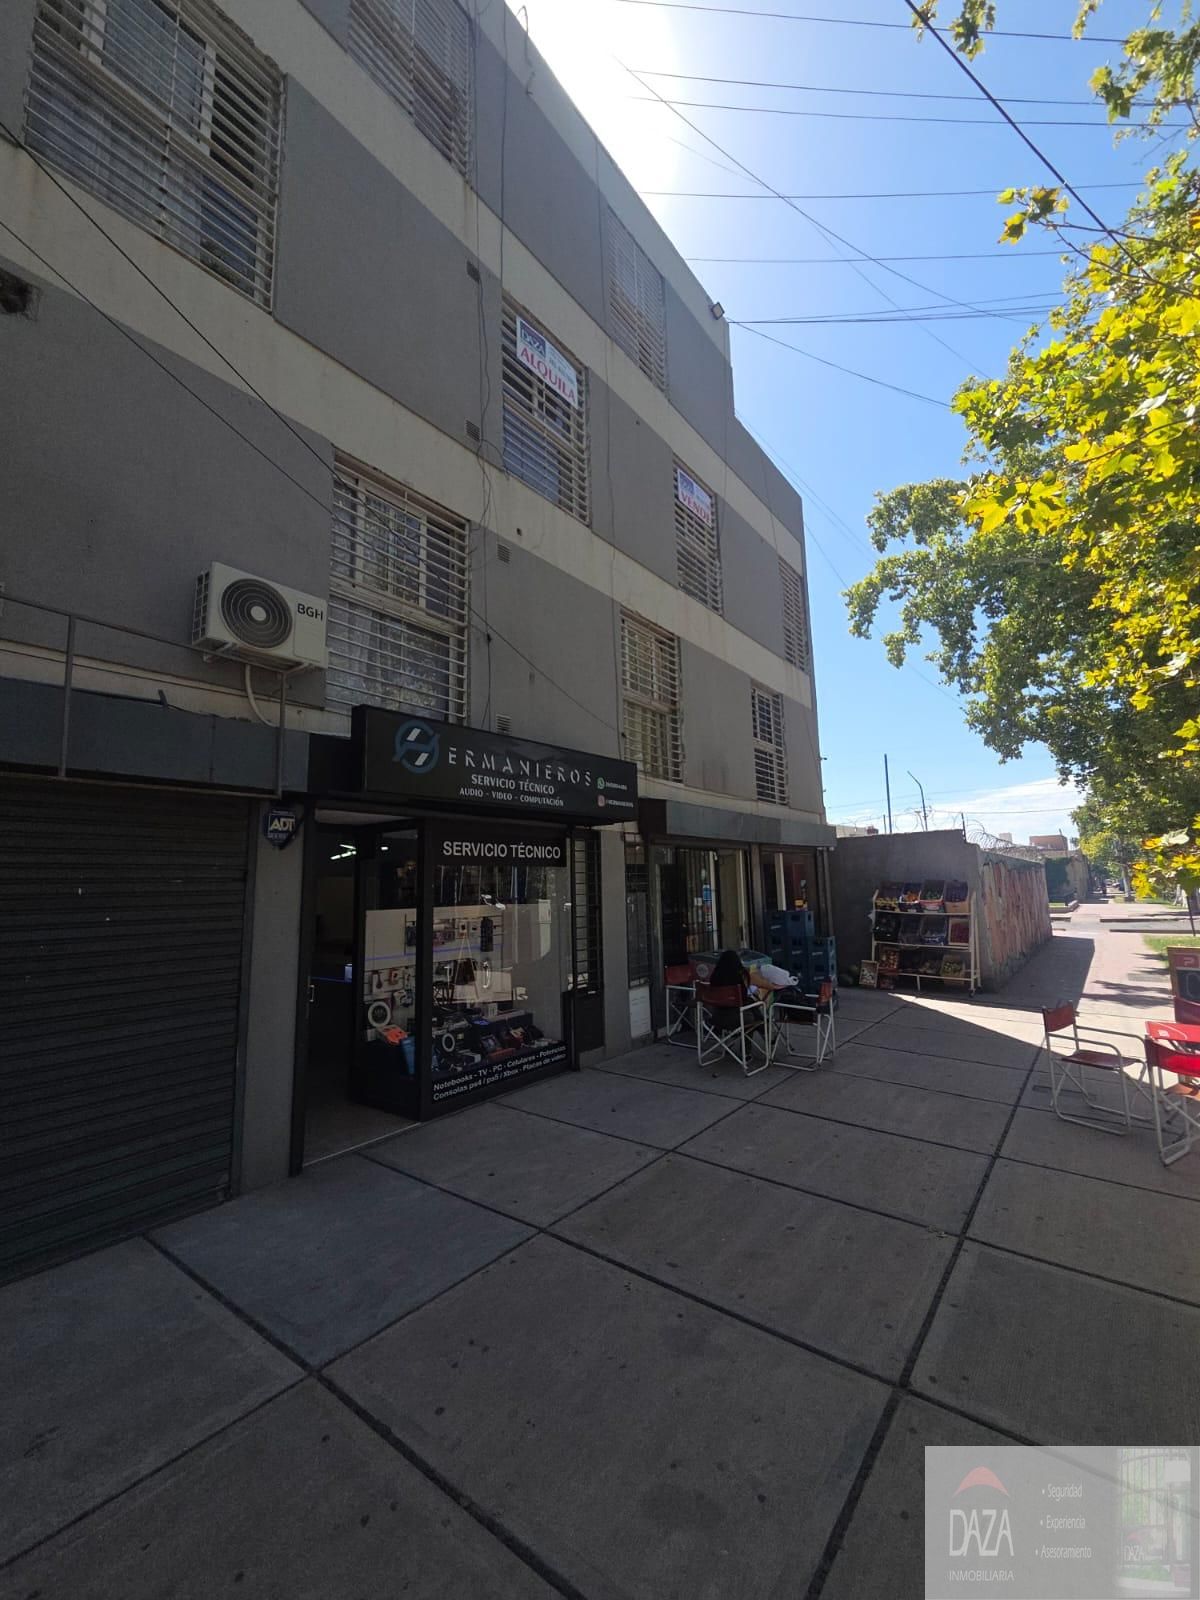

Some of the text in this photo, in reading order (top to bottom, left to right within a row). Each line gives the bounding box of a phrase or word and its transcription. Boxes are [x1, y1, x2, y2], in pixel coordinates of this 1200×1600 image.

[521, 346, 576, 404] ALQUILA
[297, 602, 324, 622] BGH
[459, 786, 484, 798] AUDIO
[491, 790, 514, 801] VIDEO
[471, 773, 556, 796] SERVICIO TÉCNICO
[270, 817, 295, 832] ADT
[442, 840, 561, 860] SERVICIO TÉCNICO
[433, 1073, 473, 1091] Notebooks
[478, 1068, 488, 1078] TV
[492, 1063, 503, 1073] PC
[433, 1085, 469, 1101] Consolas
